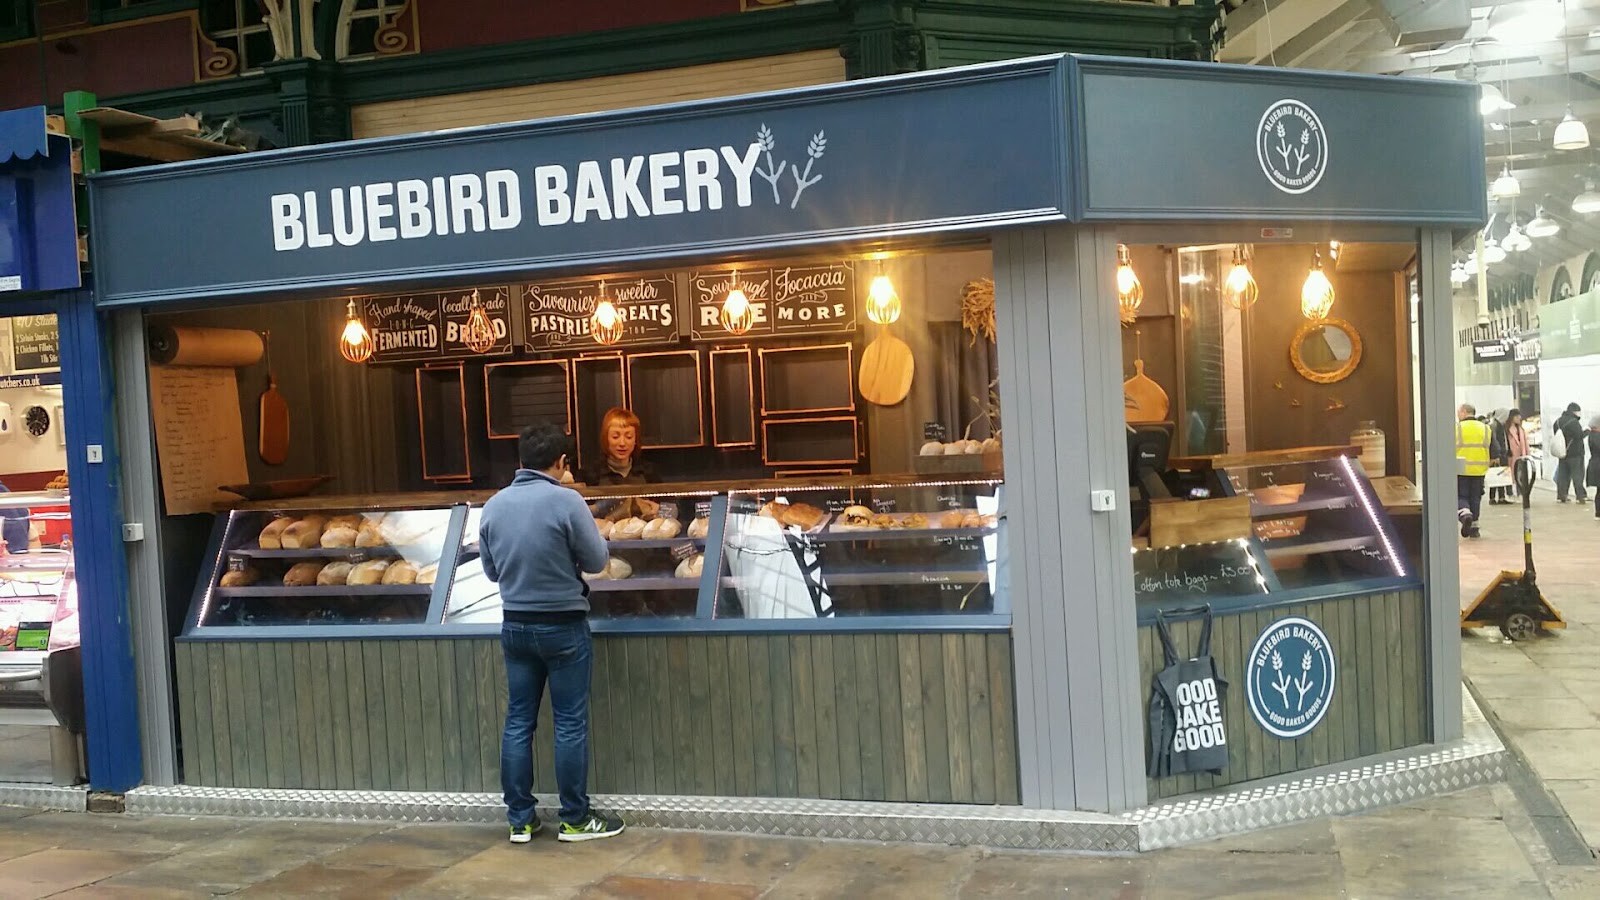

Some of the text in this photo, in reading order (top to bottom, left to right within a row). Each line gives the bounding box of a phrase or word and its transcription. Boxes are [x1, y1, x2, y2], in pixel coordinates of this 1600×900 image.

[1264, 106, 1319, 132] BLUEBIRD BAKERY
[271, 142, 762, 252] BLUEBIRD BAKERY
[615, 278, 659, 305] sweeter
[697, 278, 770, 303] Sourough
[775, 266, 846, 302] Focaccia
[369, 297, 438, 326] Hand shaped
[442, 296, 473, 313] locall
[529, 286, 597, 313] Savouries
[778, 303, 846, 321] MORE
[617, 303, 672, 326] REATS
[700, 303, 768, 326] RE
[371, 324, 438, 352] FERMENTED
[446, 318, 507, 344] BREAD
[1184, 571, 1208, 593] bags
[1256, 626, 1322, 667] BLUEBIRD BAKERY
[1176, 678, 1217, 706] OOD
[1269, 711, 1285, 726] GOOD
[1285, 714, 1305, 727] BAKED
[1174, 722, 1226, 753] GOOD
